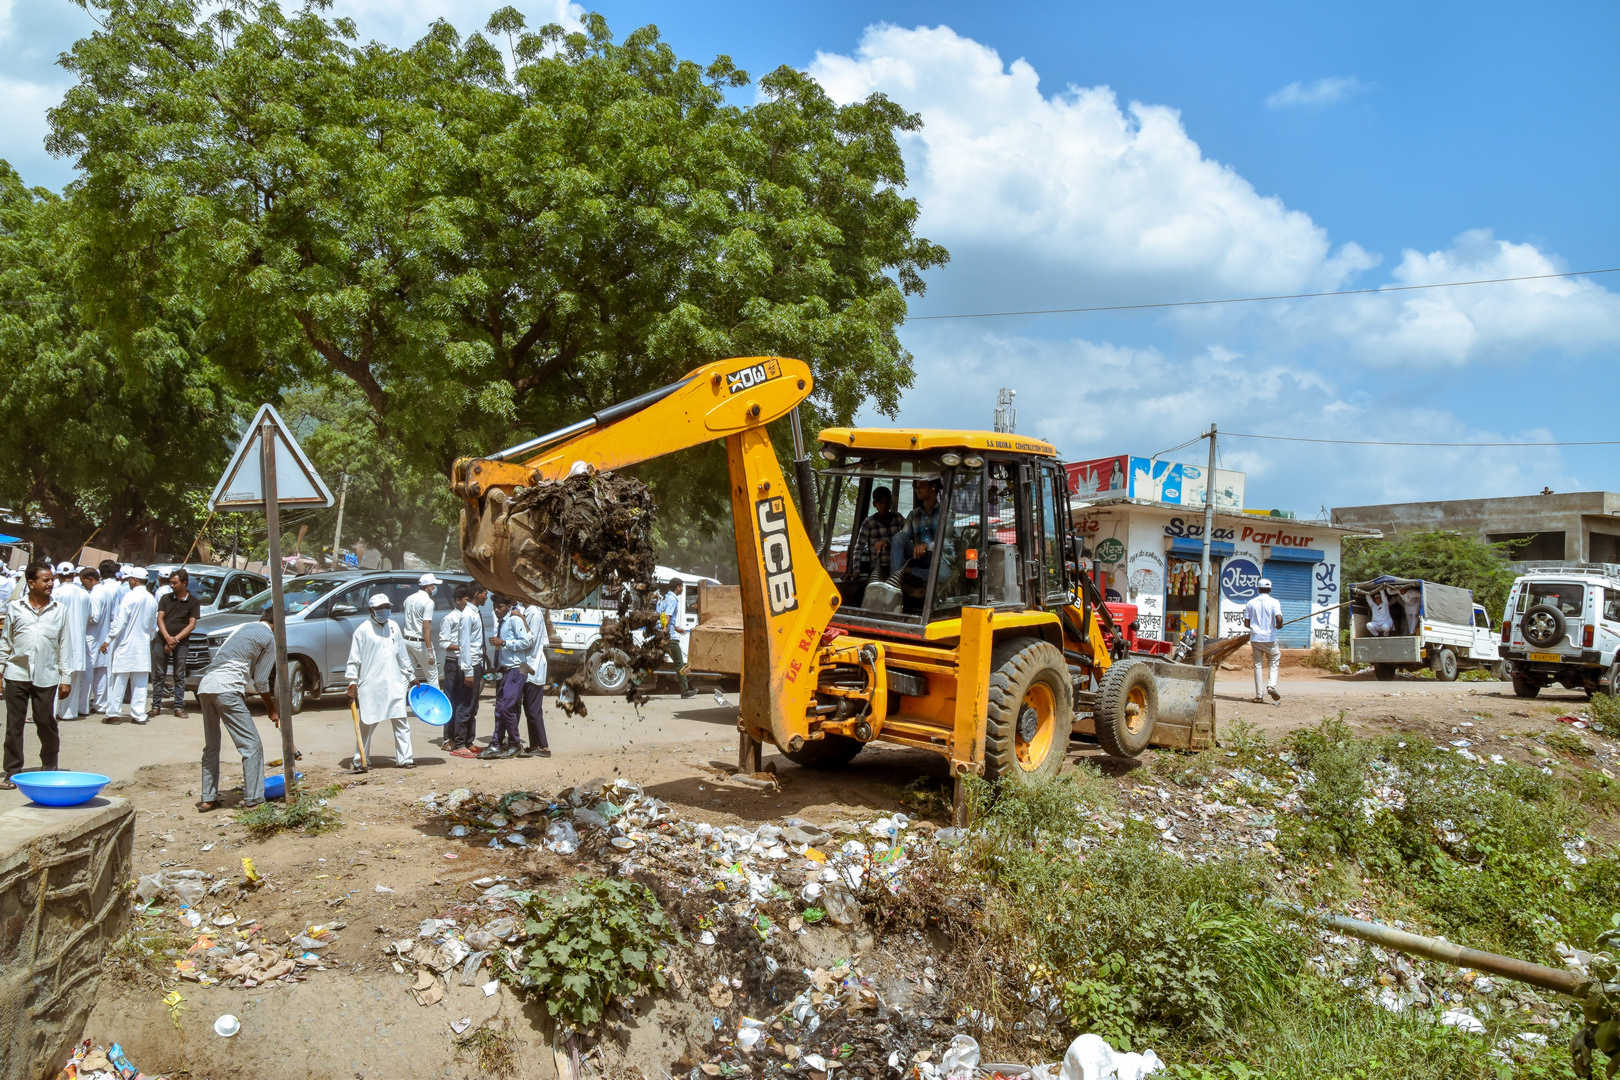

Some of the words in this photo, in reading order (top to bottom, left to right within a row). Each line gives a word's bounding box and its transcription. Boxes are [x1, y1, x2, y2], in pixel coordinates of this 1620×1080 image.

[1164, 517, 1235, 540] Saas
[1240, 527, 1315, 548] Parlour
[758, 502, 796, 613] JCB
[1223, 567, 1260, 597] सरस
[1068, 590, 1081, 609] CB
